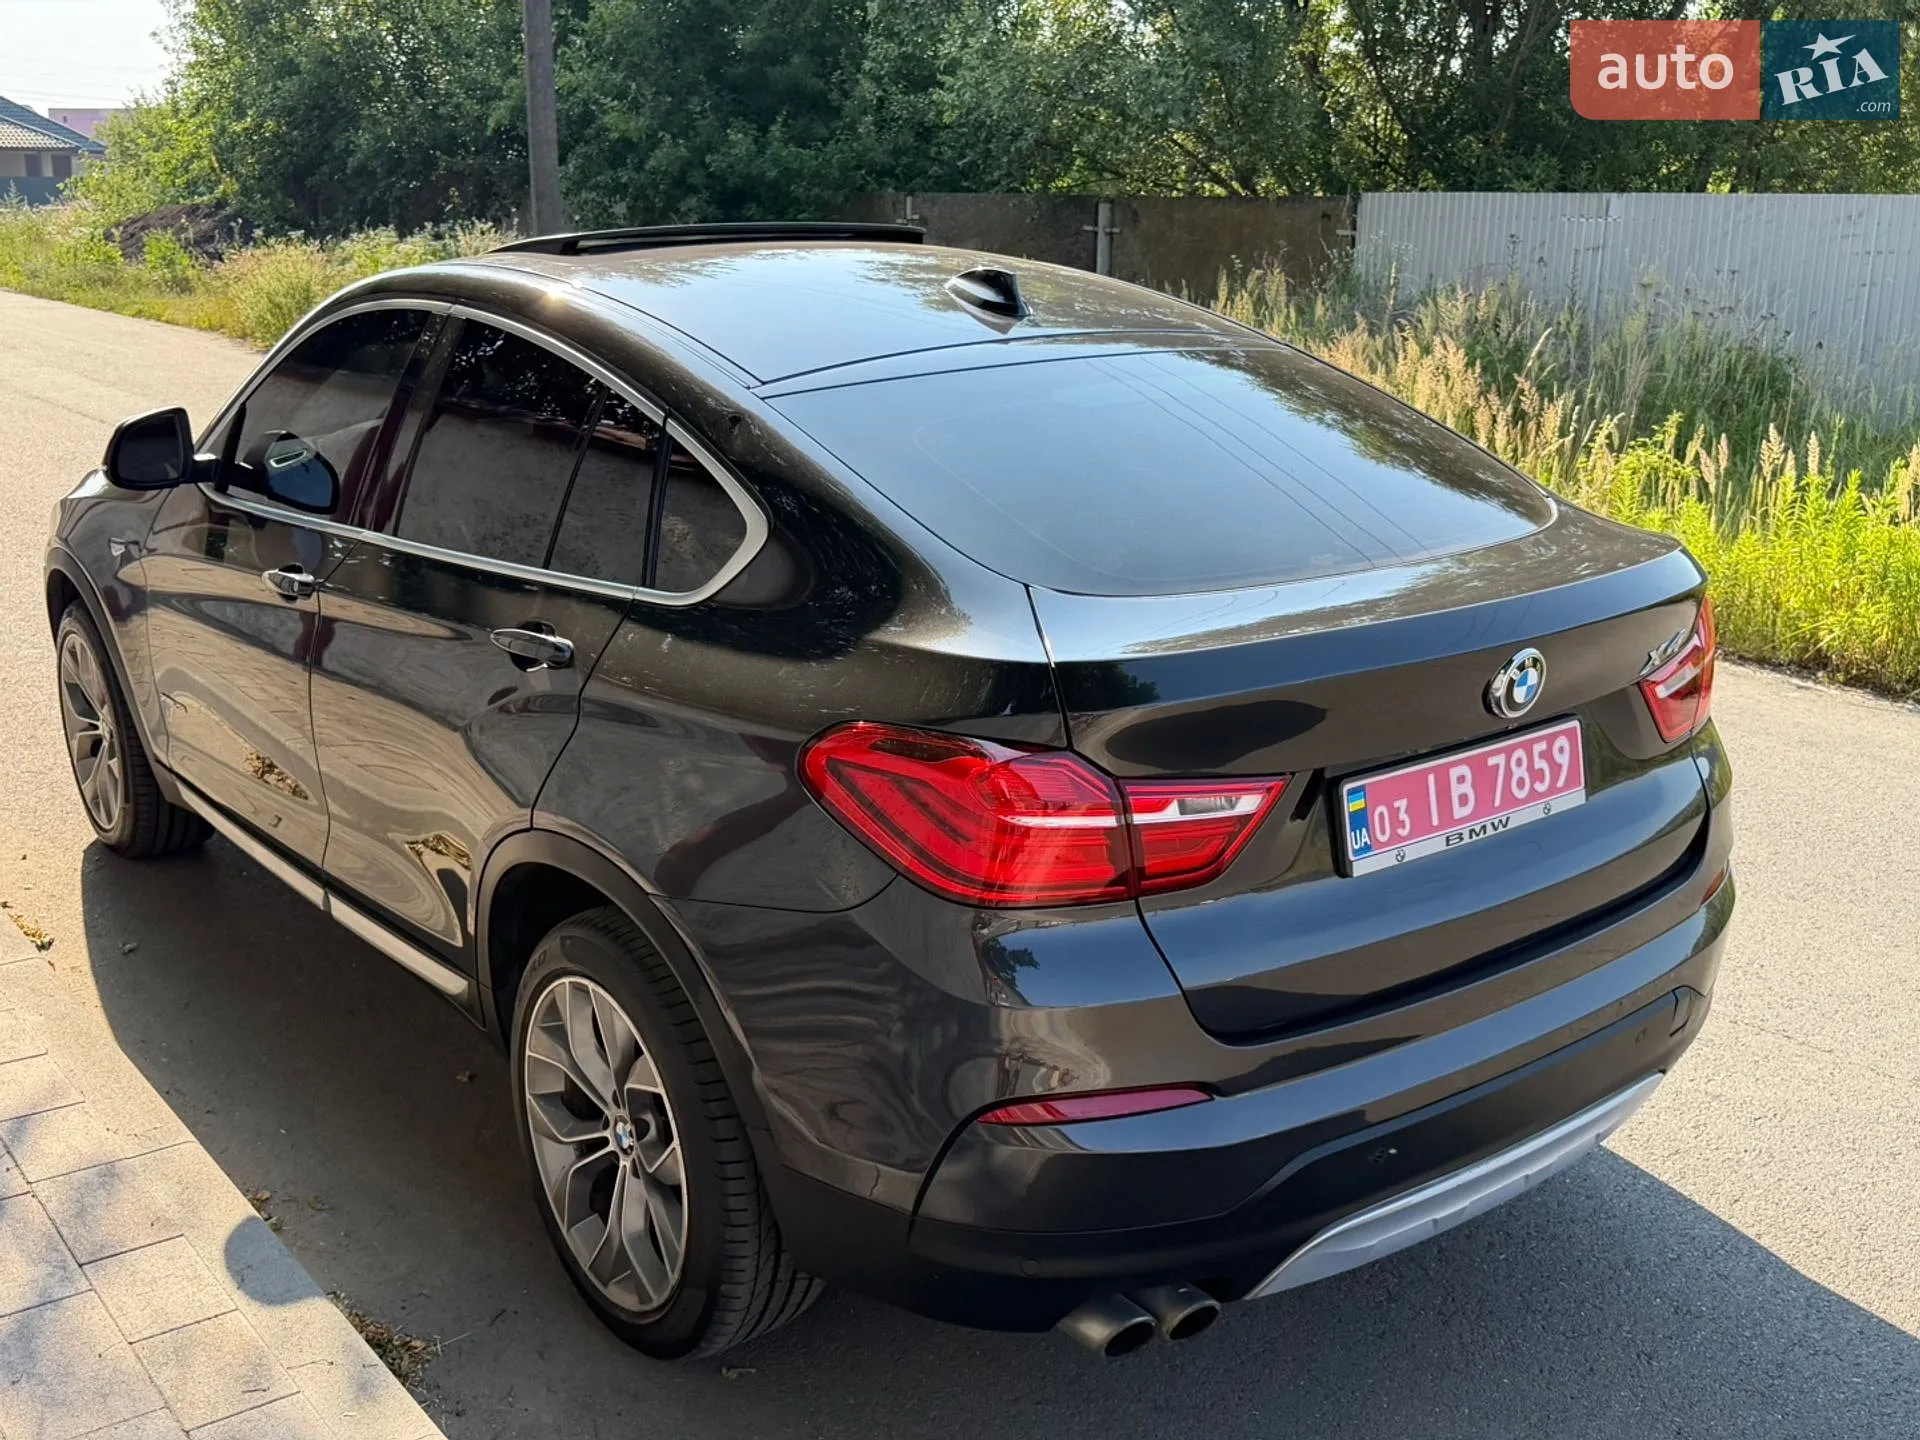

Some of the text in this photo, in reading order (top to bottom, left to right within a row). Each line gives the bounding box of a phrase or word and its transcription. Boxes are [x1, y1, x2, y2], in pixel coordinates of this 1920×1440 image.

[1373, 798, 1411, 843] 03
[1487, 735, 1571, 808] 7859
[1351, 827, 1371, 850] UA
[1445, 816, 1511, 848] BMW
